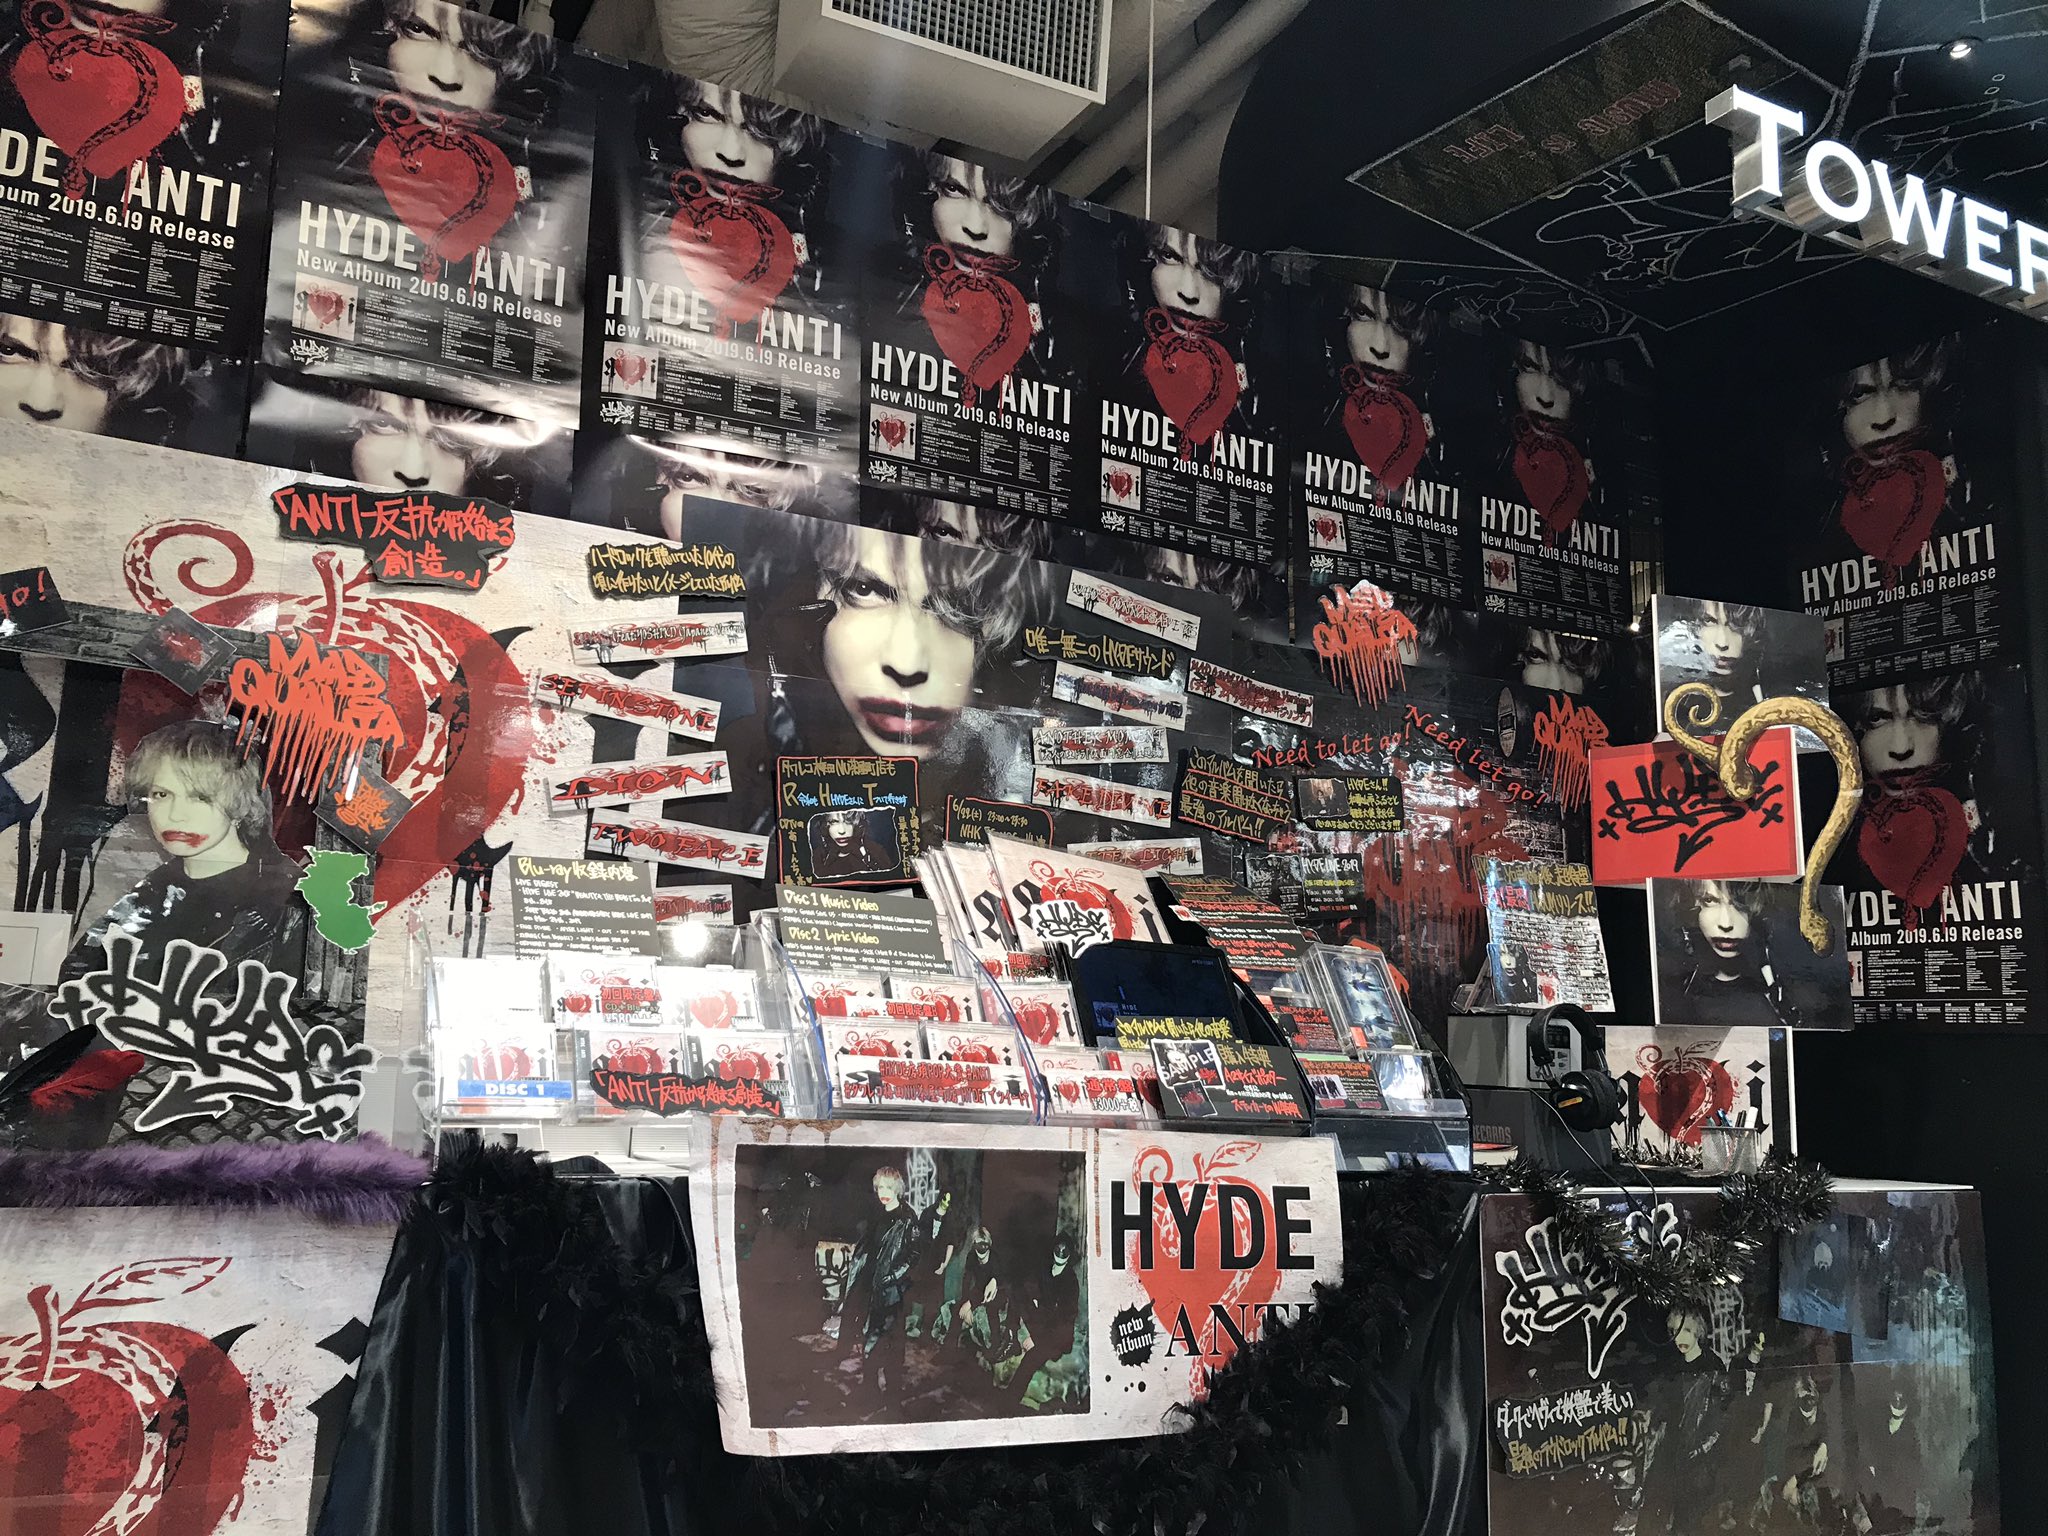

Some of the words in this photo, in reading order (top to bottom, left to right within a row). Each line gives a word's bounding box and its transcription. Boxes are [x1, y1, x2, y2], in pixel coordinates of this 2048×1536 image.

[0, 128, 63, 187] DE
[121, 158, 241, 228] ANTI
[48, 192, 143, 231] 2019.6.19
[149, 215, 235, 250] Release
[299, 200, 418, 272] HYDE
[468, 245, 566, 307] ANTI
[296, 248, 338, 271] New
[342, 259, 402, 291] Album
[409, 276, 488, 310] 2019.6.19
[492, 297, 563, 328] Release
[605, 274, 710, 332] HYDE
[755, 305, 842, 360] ANTI
[604, 318, 640, 338] New
[644, 325, 697, 348] Album
[702, 336, 773, 366] 2019.6.19
[777, 353, 841, 379] Release
[870, 341, 960, 399] HYDE
[997, 373, 1071, 424] ANTI
[870, 383, 901, 401] New
[903, 391, 949, 416] Album
[953, 402, 1013, 430] 2019.6.19
[1016, 417, 1071, 443] Release
[1101, 399, 1177, 453] HYDE
[1209, 429, 1274, 476] ANTI
[1101, 438, 1127, 457] New
[1129, 446, 1169, 469] Album
[1172, 456, 1224, 481] 2019.6.19
[1226, 470, 1273, 494] Release
[1304, 450, 1373, 500] HYDE
[1401, 476, 1459, 520] ANTI
[1305, 488, 1329, 504] New
[1330, 497, 1366, 515] Album
[1368, 503, 1415, 526] 2019.6.19
[1416, 514, 1459, 536] Release
[1481, 496, 1542, 541] HYDE
[1567, 518, 1619, 559] ANTI
[1480, 531, 1502, 547] New
[1503, 538, 1535, 556] Album
[1537, 544, 1580, 566] 2019.6.19
[1581, 554, 1619, 575] Release
[1801, 555, 1881, 603] HYDE
[1918, 523, 1996, 577] ANTI
[1833, 594, 1872, 615] Album
[1937, 566, 1996, 591] Release
[539, 673, 595, 700] SET
[596, 690, 632, 711] IN
[633, 698, 717, 731] STONE
[1252, 740, 1315, 769] Need
[1315, 739, 1338, 759] to
[1342, 733, 1374, 756] let
[1404, 704, 1467, 764] Need
[1468, 749, 1507, 784] let
[1507, 780, 1550, 810] go!
[552, 760, 727, 801] LION
[1033, 777, 1093, 805] FAKE
[591, 822, 666, 849] TWO
[677, 835, 764, 867] FACE
[960, 823, 982, 840] NHK
[1140, 846, 1200, 864] LIGHT
[820, 892, 851, 910] Music
[852, 897, 880, 912] Video
[1846, 889, 1901, 928] YDE
[1939, 880, 2022, 923] ANTI
[851, 930, 880, 945] Video
[1850, 931, 1892, 946] Album
[1961, 925, 2024, 942] Release
[485, 1083, 528, 1096] DISC
[535, 1084, 545, 1096] 1
[1160, 1047, 1216, 1081] SAMPLE
[1110, 1180, 1316, 1270] HYDE
[1116, 1332, 1153, 1356] album
[1118, 1316, 1144, 1337] new
[1164, 1303, 1318, 1358] AN
